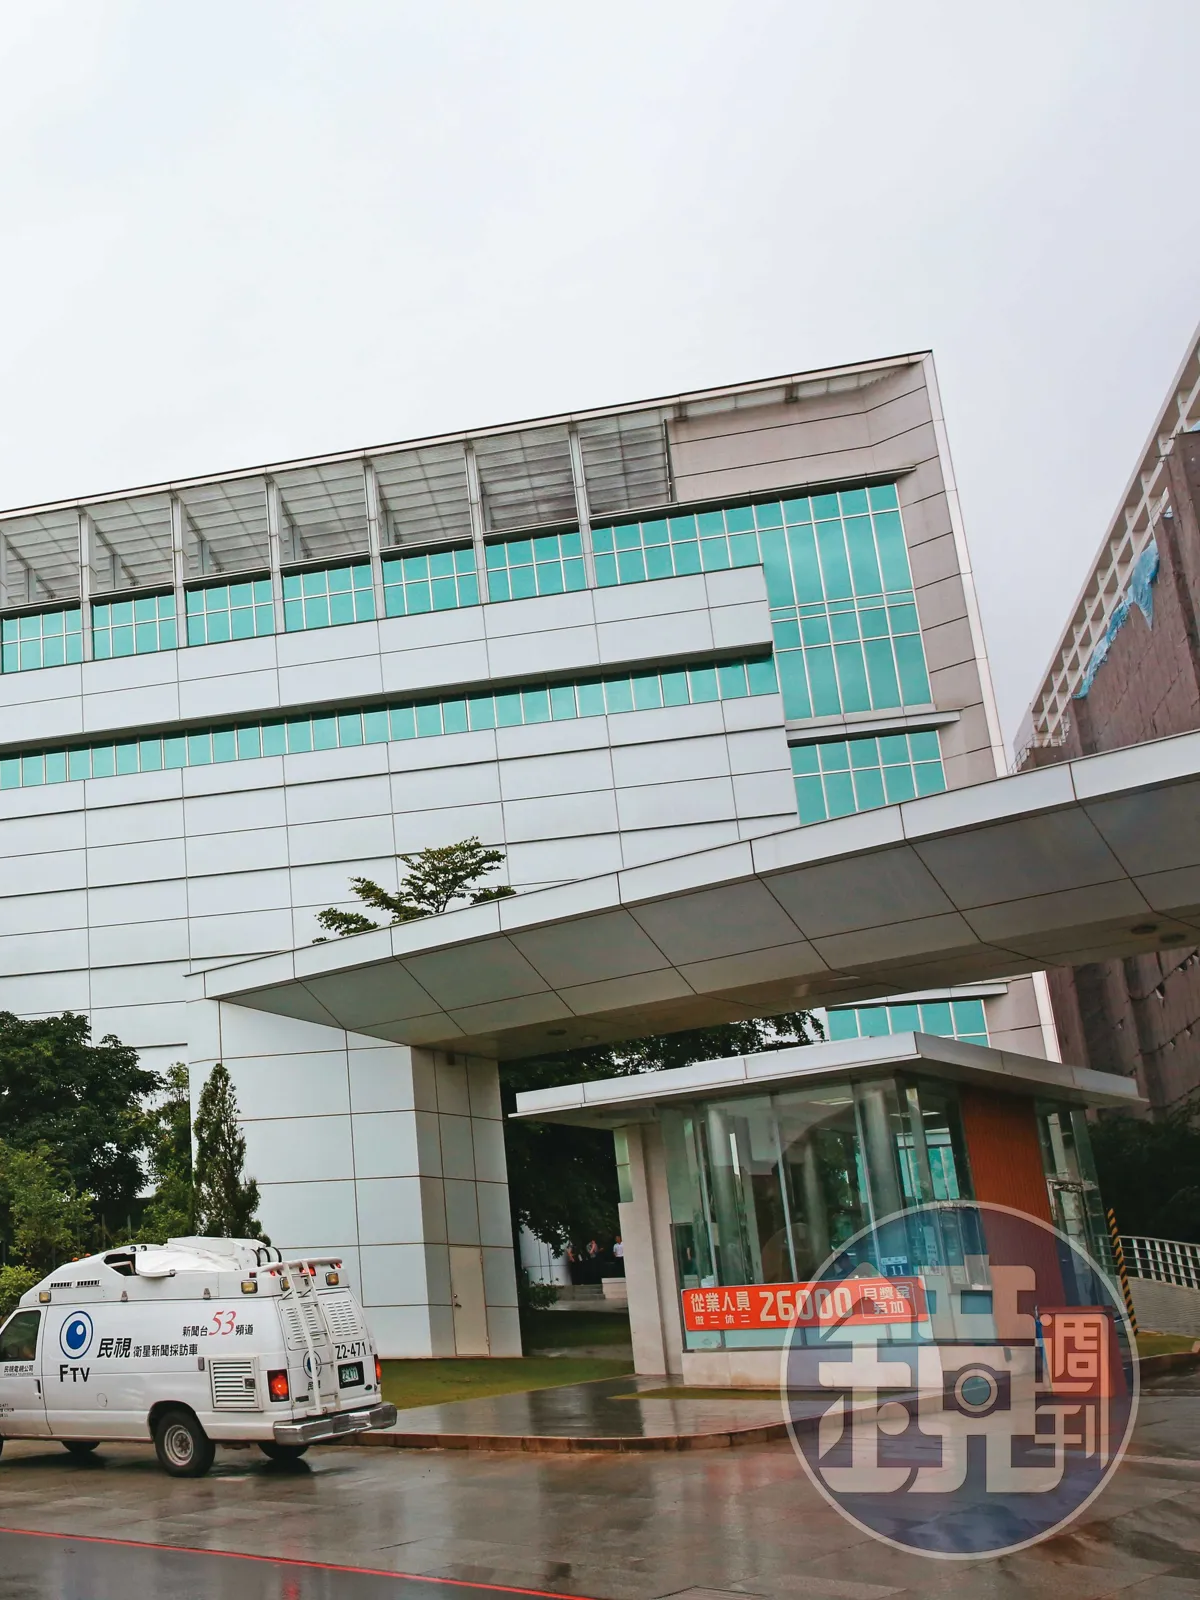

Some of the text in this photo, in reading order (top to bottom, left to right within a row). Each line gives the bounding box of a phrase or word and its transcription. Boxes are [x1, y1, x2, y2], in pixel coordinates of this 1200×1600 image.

[690, 1291, 751, 1312] 從業人員
[759, 1289, 852, 1322] 26000
[97, 1338, 198, 1358] 民視 衛星新聞採訪車
[335, 1341, 366, 1360] Z2-471
[60, 1364, 90, 1382] FTV
